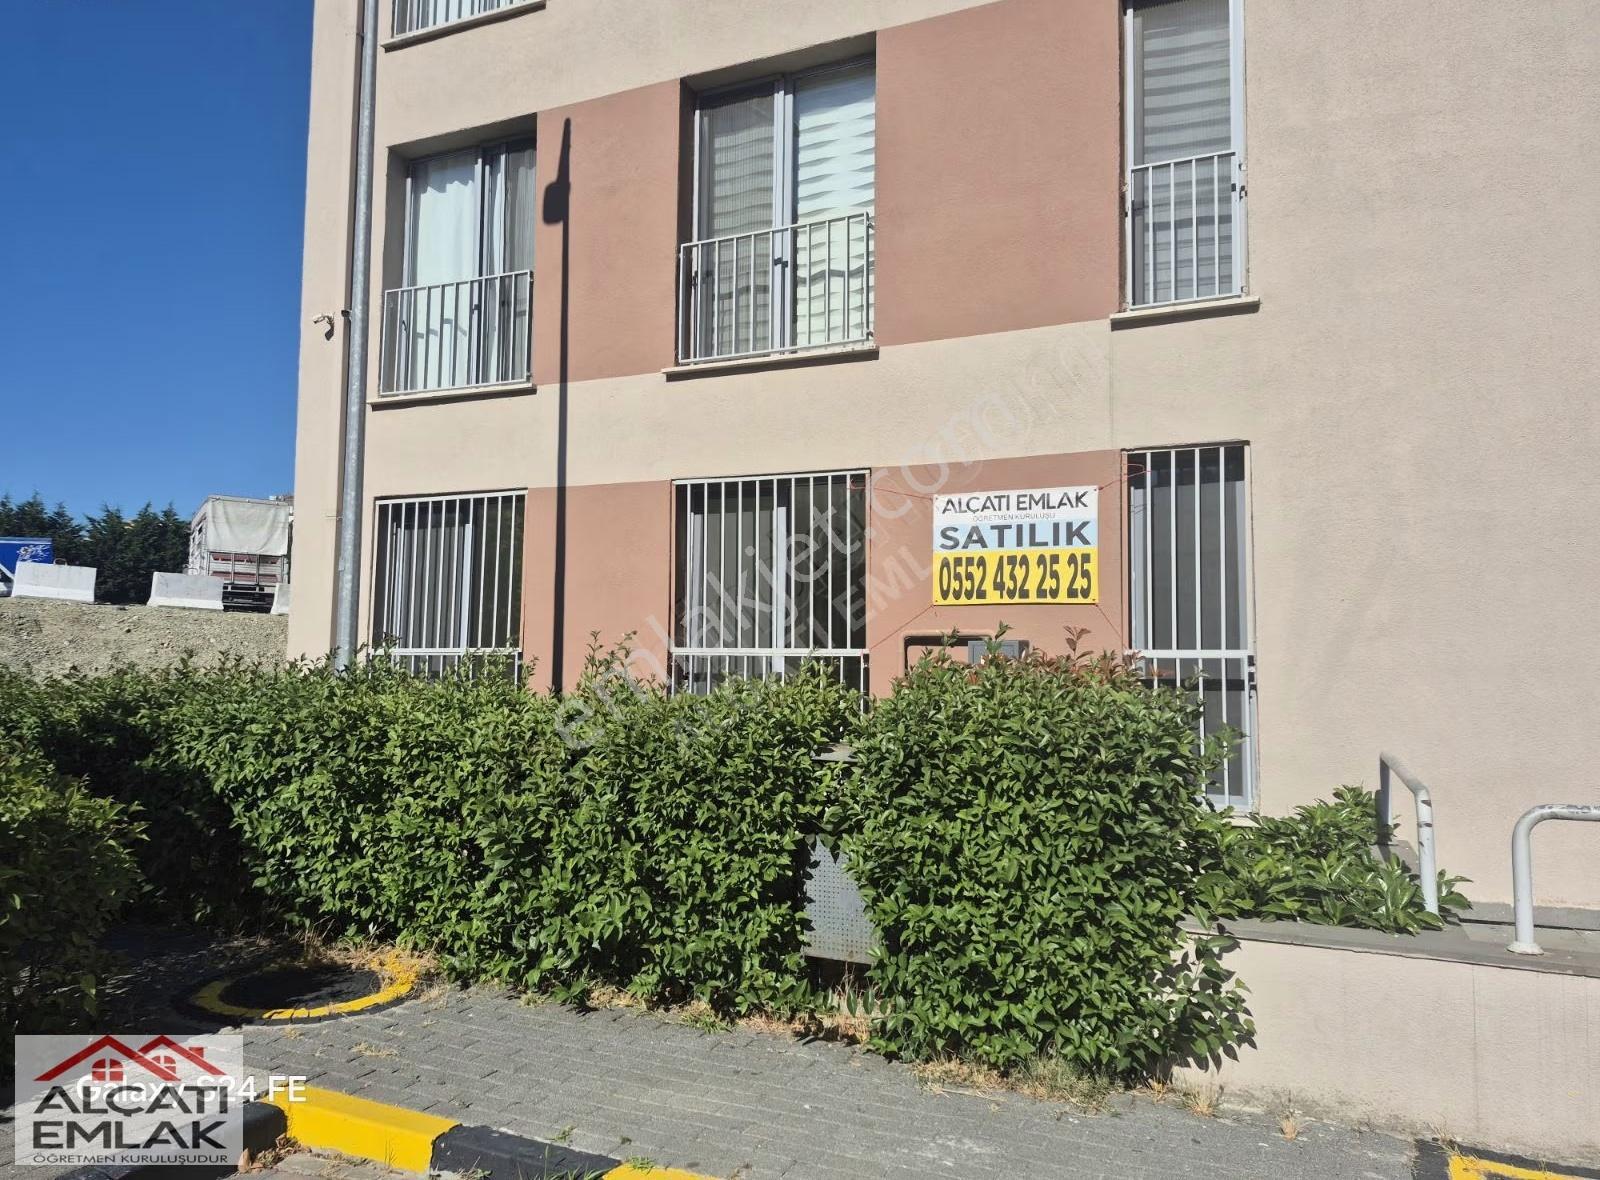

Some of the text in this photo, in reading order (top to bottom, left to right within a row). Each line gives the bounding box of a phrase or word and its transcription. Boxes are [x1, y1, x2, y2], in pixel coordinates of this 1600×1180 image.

[942, 491, 1089, 514] ALÇATI EMLAK
[939, 520, 1091, 550] SATILIK
[939, 552, 1092, 600] 0552 432 25 25
